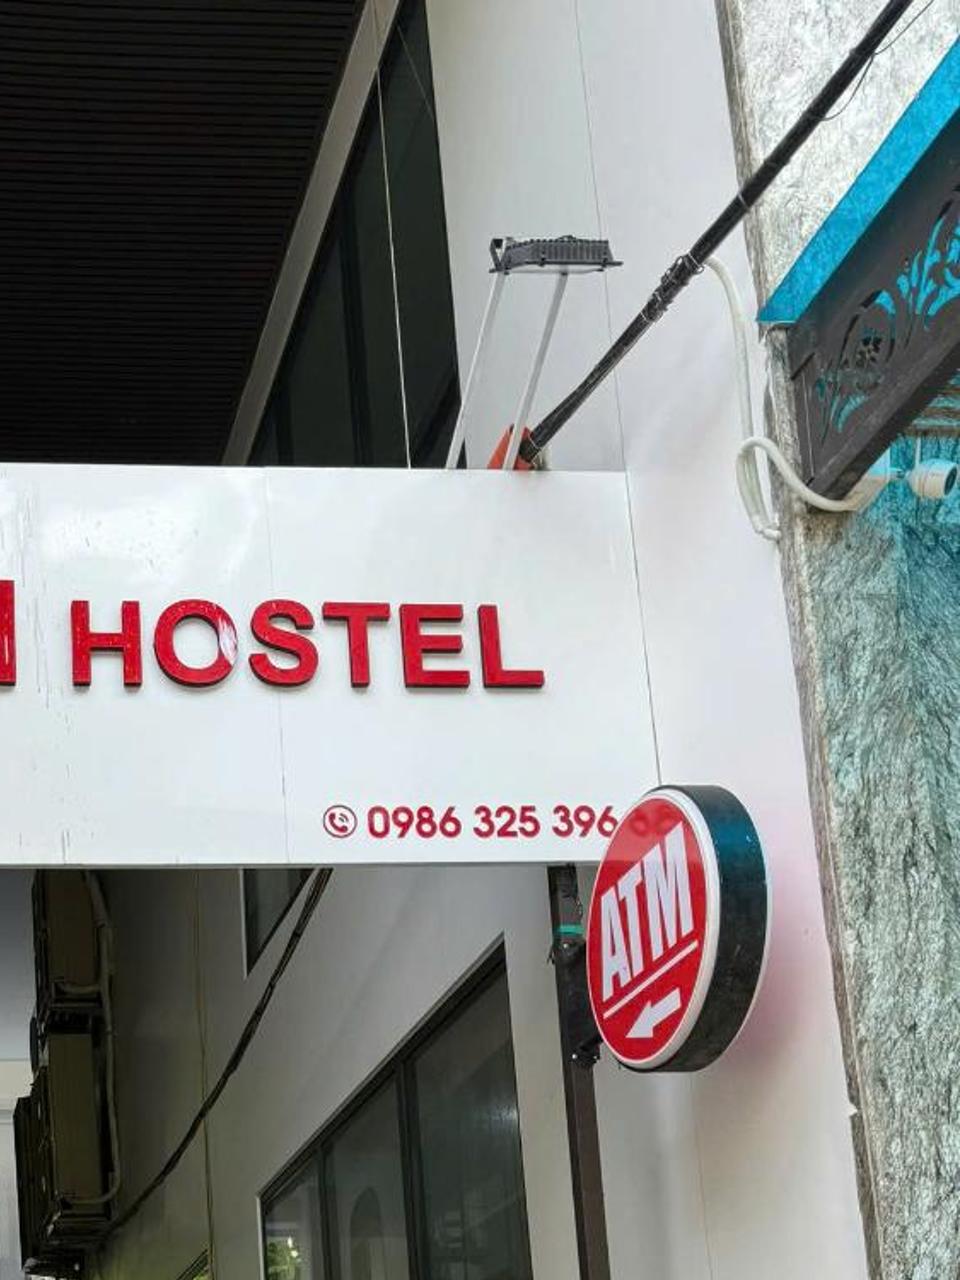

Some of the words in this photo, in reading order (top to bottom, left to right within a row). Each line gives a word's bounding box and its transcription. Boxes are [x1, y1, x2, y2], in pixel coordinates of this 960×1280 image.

[70, 599, 545, 689] HOSTEL
[367, 805, 462, 838] 0986
[473, 805, 540, 838] 325
[552, 805, 618, 838] 396
[600, 821, 694, 1003] ATM
